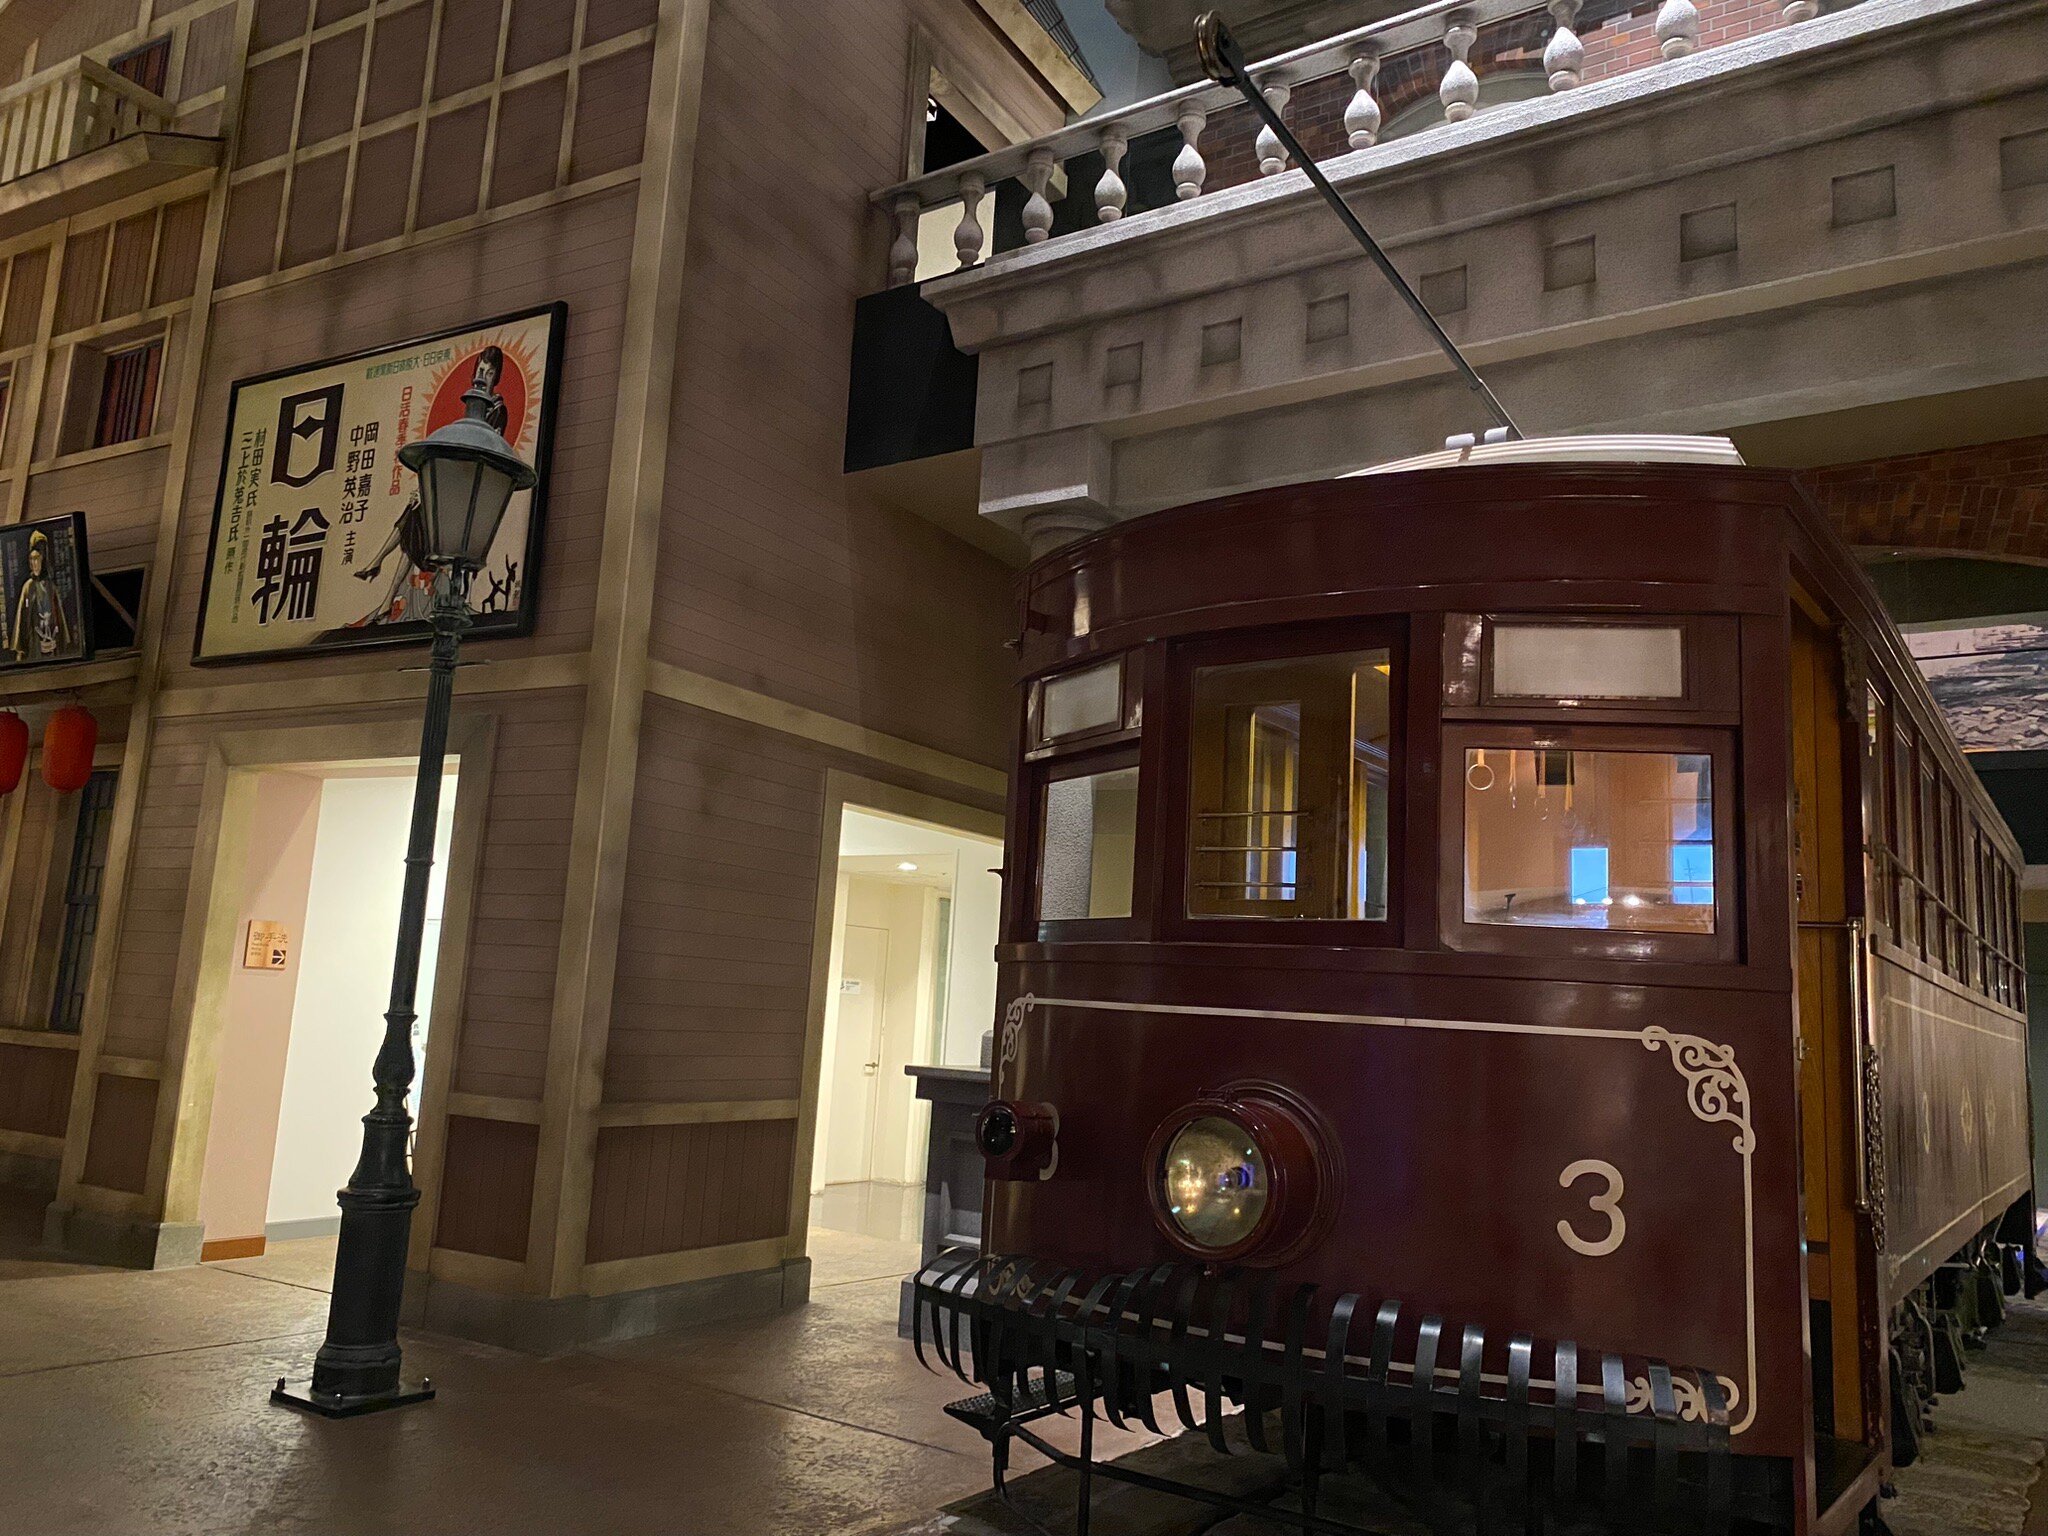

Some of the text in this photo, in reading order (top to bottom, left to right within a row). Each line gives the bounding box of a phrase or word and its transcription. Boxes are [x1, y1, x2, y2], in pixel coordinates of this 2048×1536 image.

[251, 383, 346, 625] 日輪
[338, 425, 364, 566] 中野英治 主演
[354, 421, 379, 523] 岡田嘉子
[1556, 1158, 1626, 1257] 3
